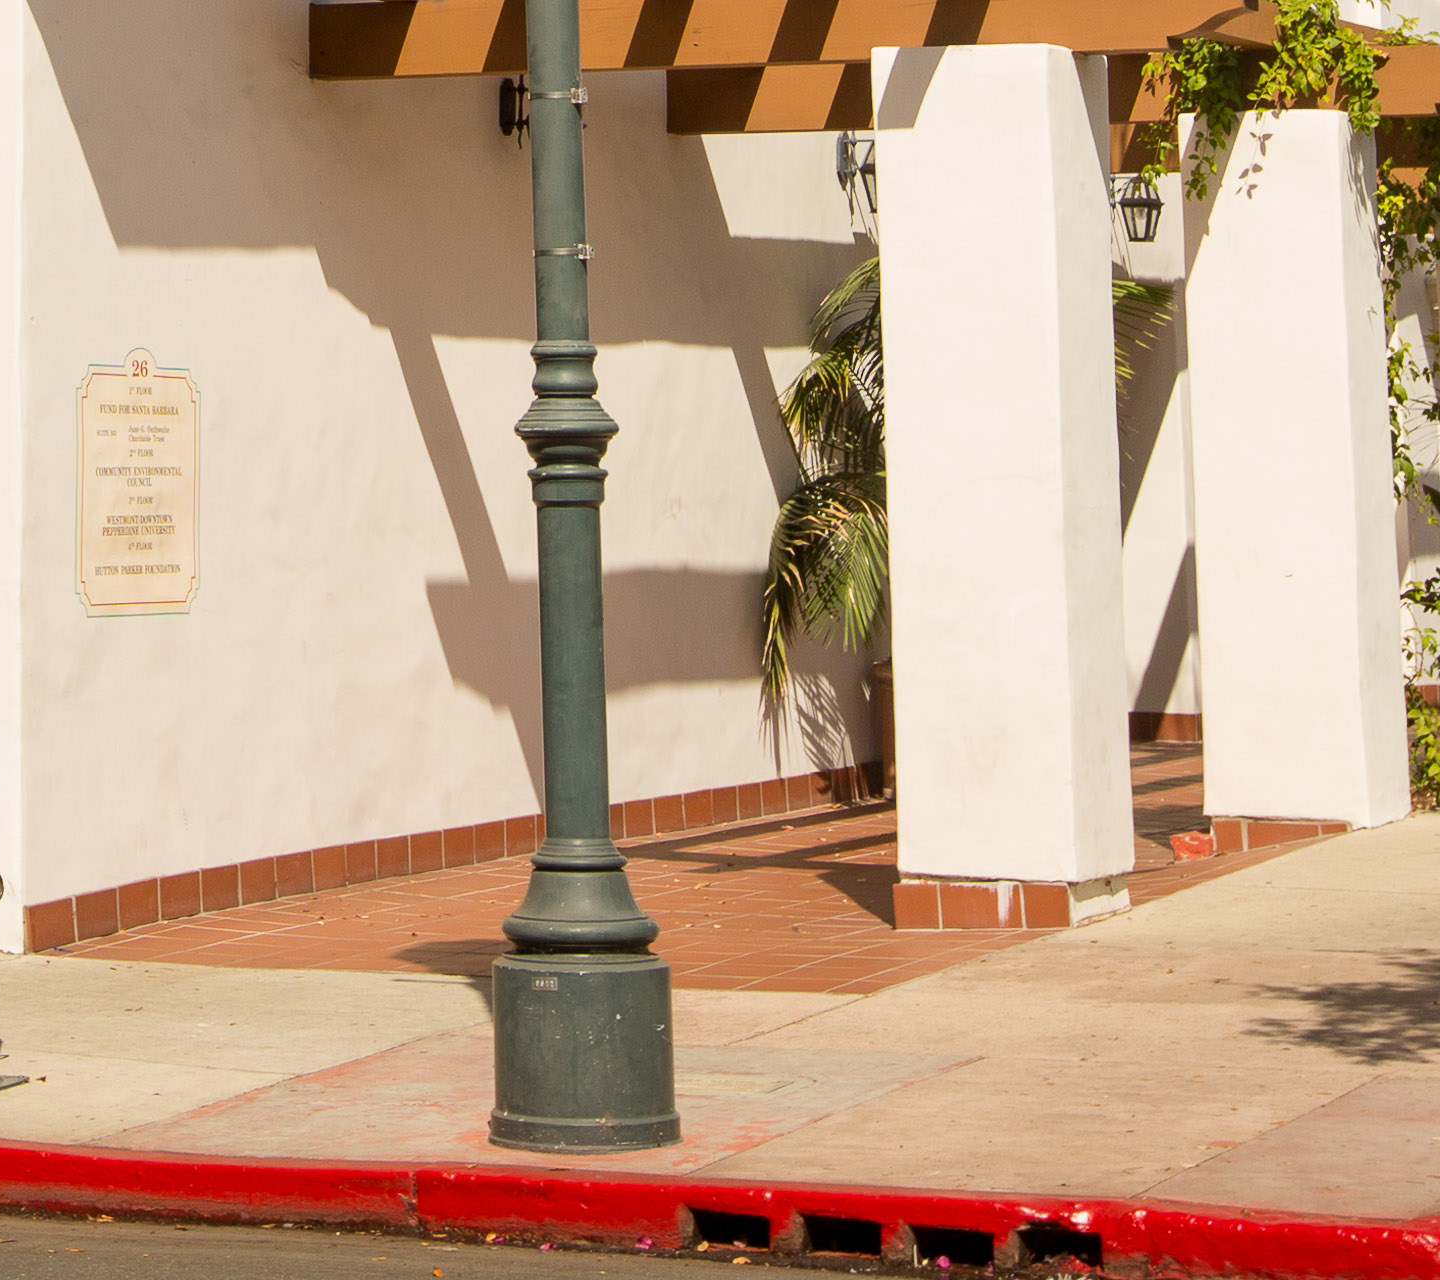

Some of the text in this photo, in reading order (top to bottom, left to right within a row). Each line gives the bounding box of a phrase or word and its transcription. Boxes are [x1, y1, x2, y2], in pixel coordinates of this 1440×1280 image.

[132, 360, 148, 377] 26
[99, 404, 117, 414] FUND
[119, 404, 130, 414] FOR
[132, 405, 151, 415] SANTA
[95, 466, 183, 477] COMMUNITY ENVIRONMENTAL
[127, 477, 153, 487] COUNCIL
[102, 525, 176, 536] PEPPERDINE UNIVERSITY
[95, 564, 181, 576] HUTTON PARKER FOUNDATION
